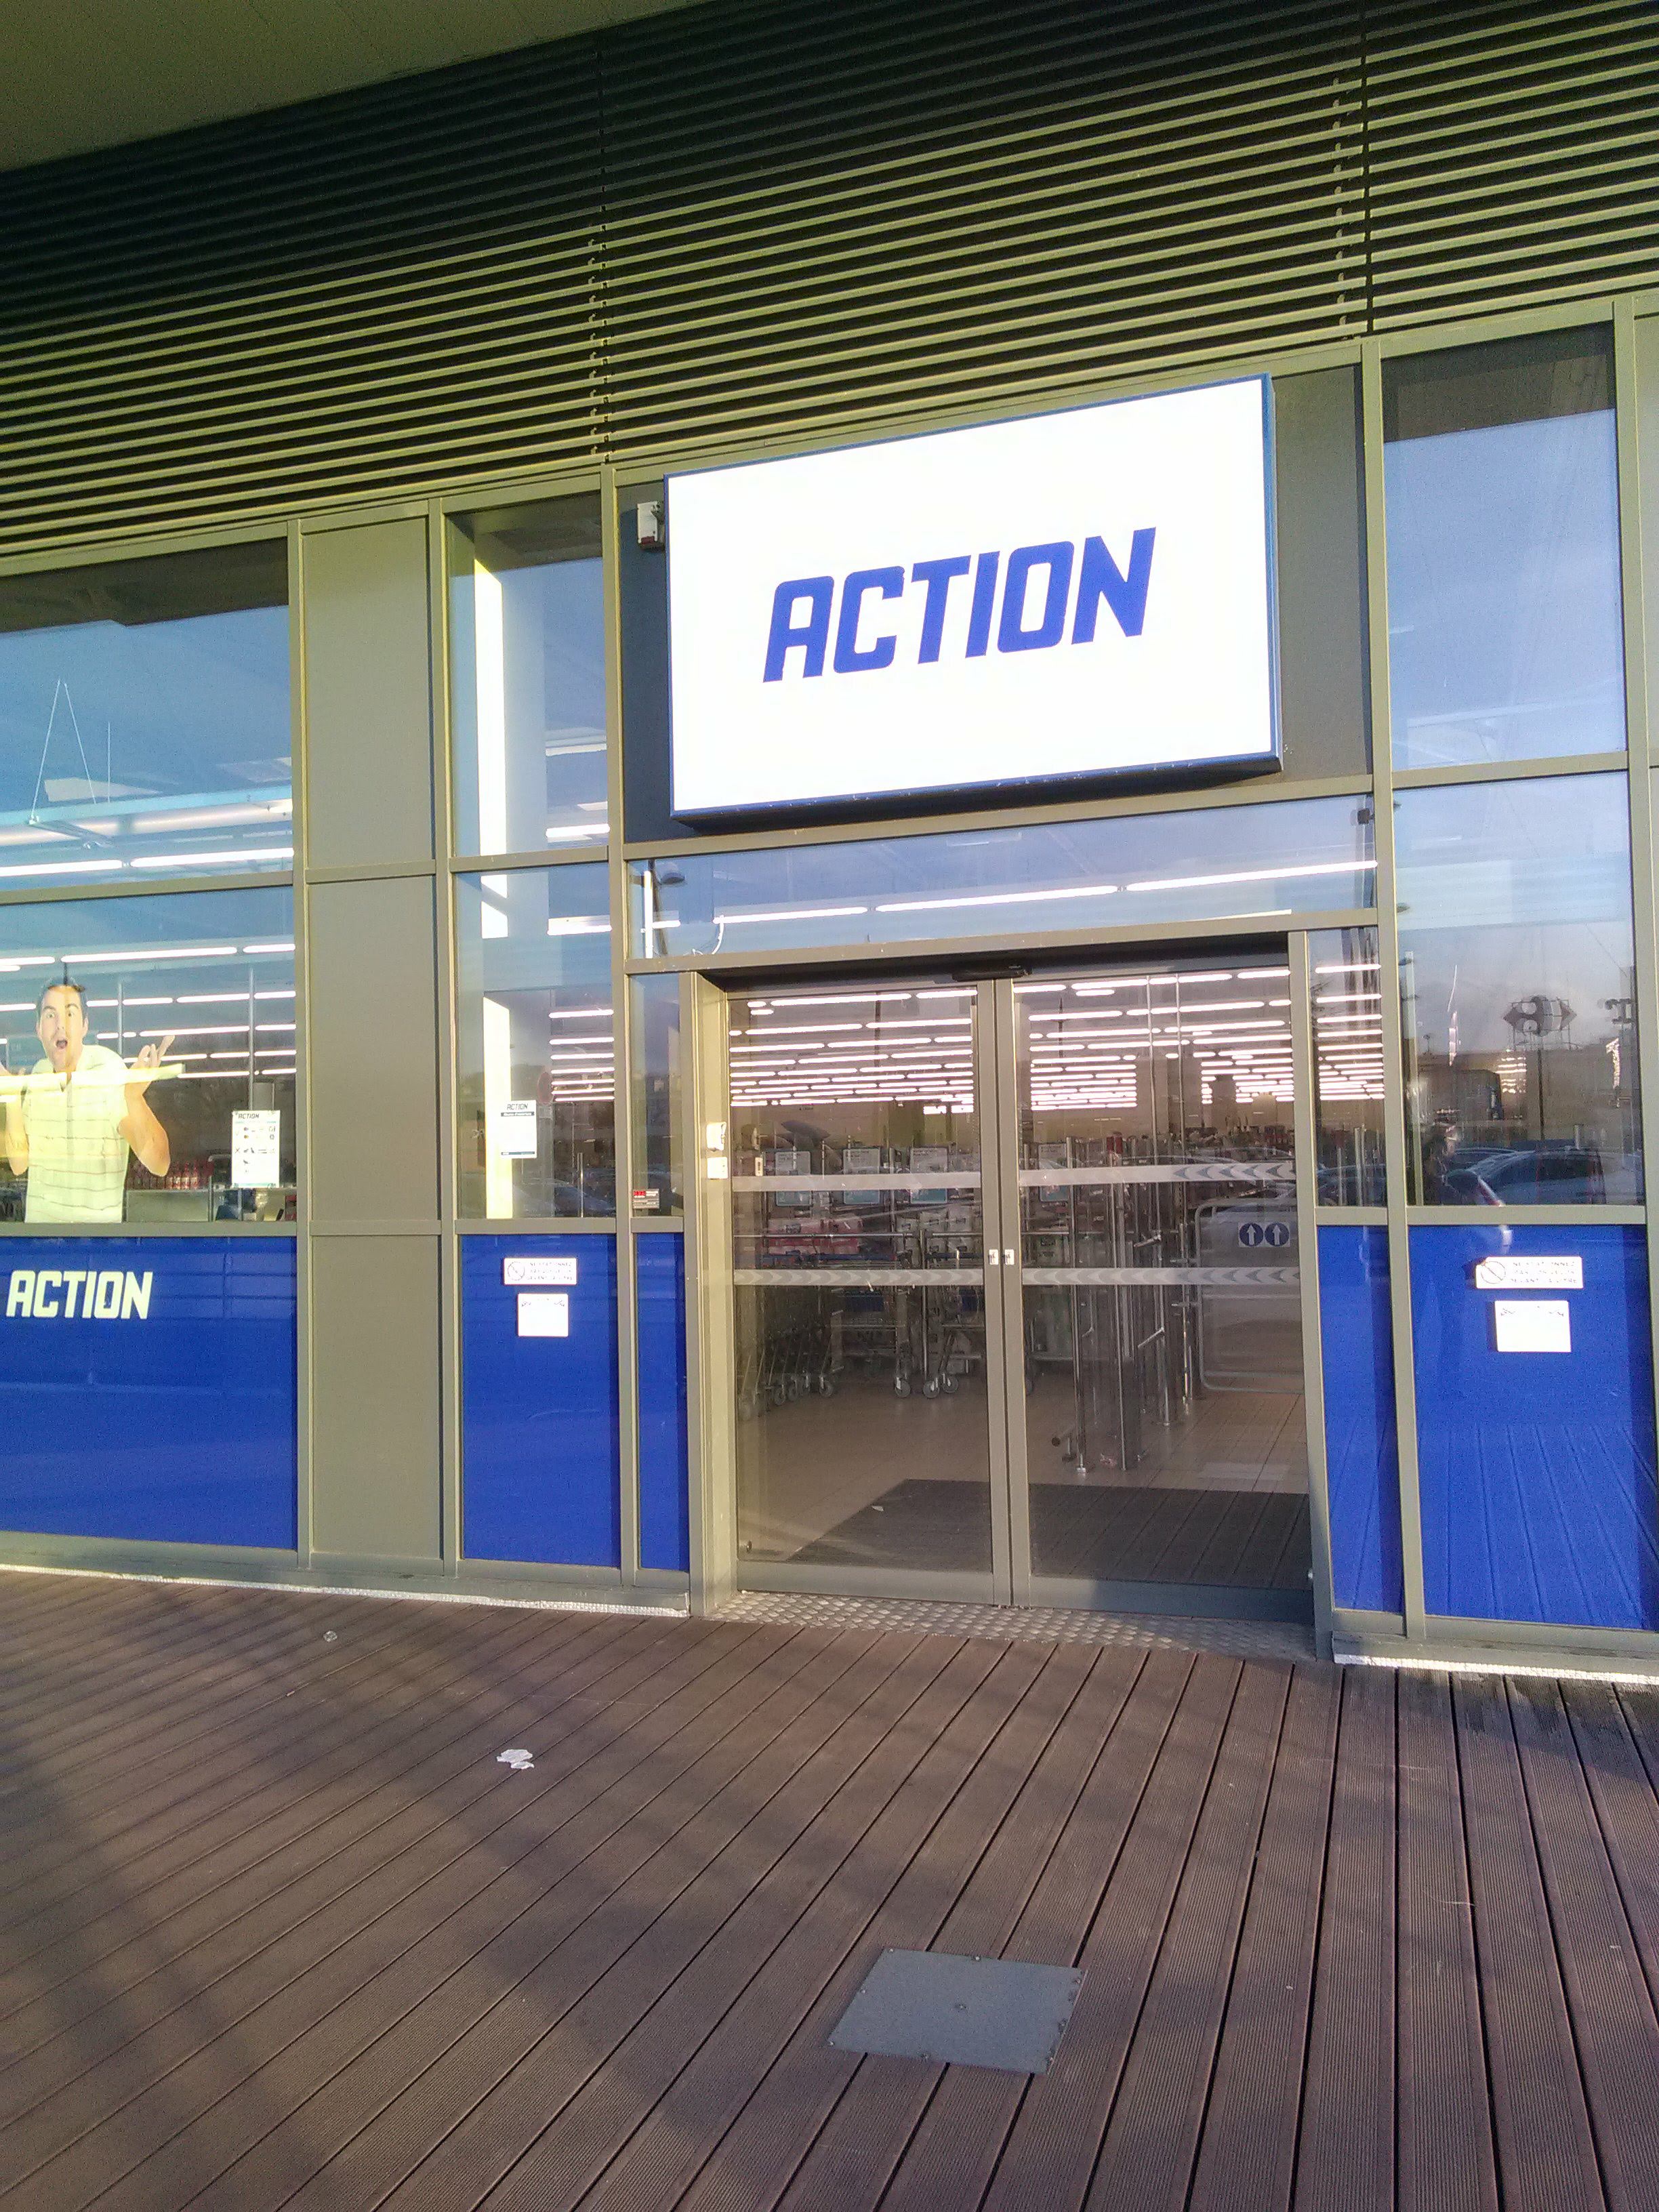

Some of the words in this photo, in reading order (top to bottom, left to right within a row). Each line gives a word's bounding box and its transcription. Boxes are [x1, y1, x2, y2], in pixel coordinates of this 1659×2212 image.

[762, 526, 1156, 683] ACTION
[506, 1103, 529, 1111] ACTION
[6, 1270, 153, 1319] ACTION
